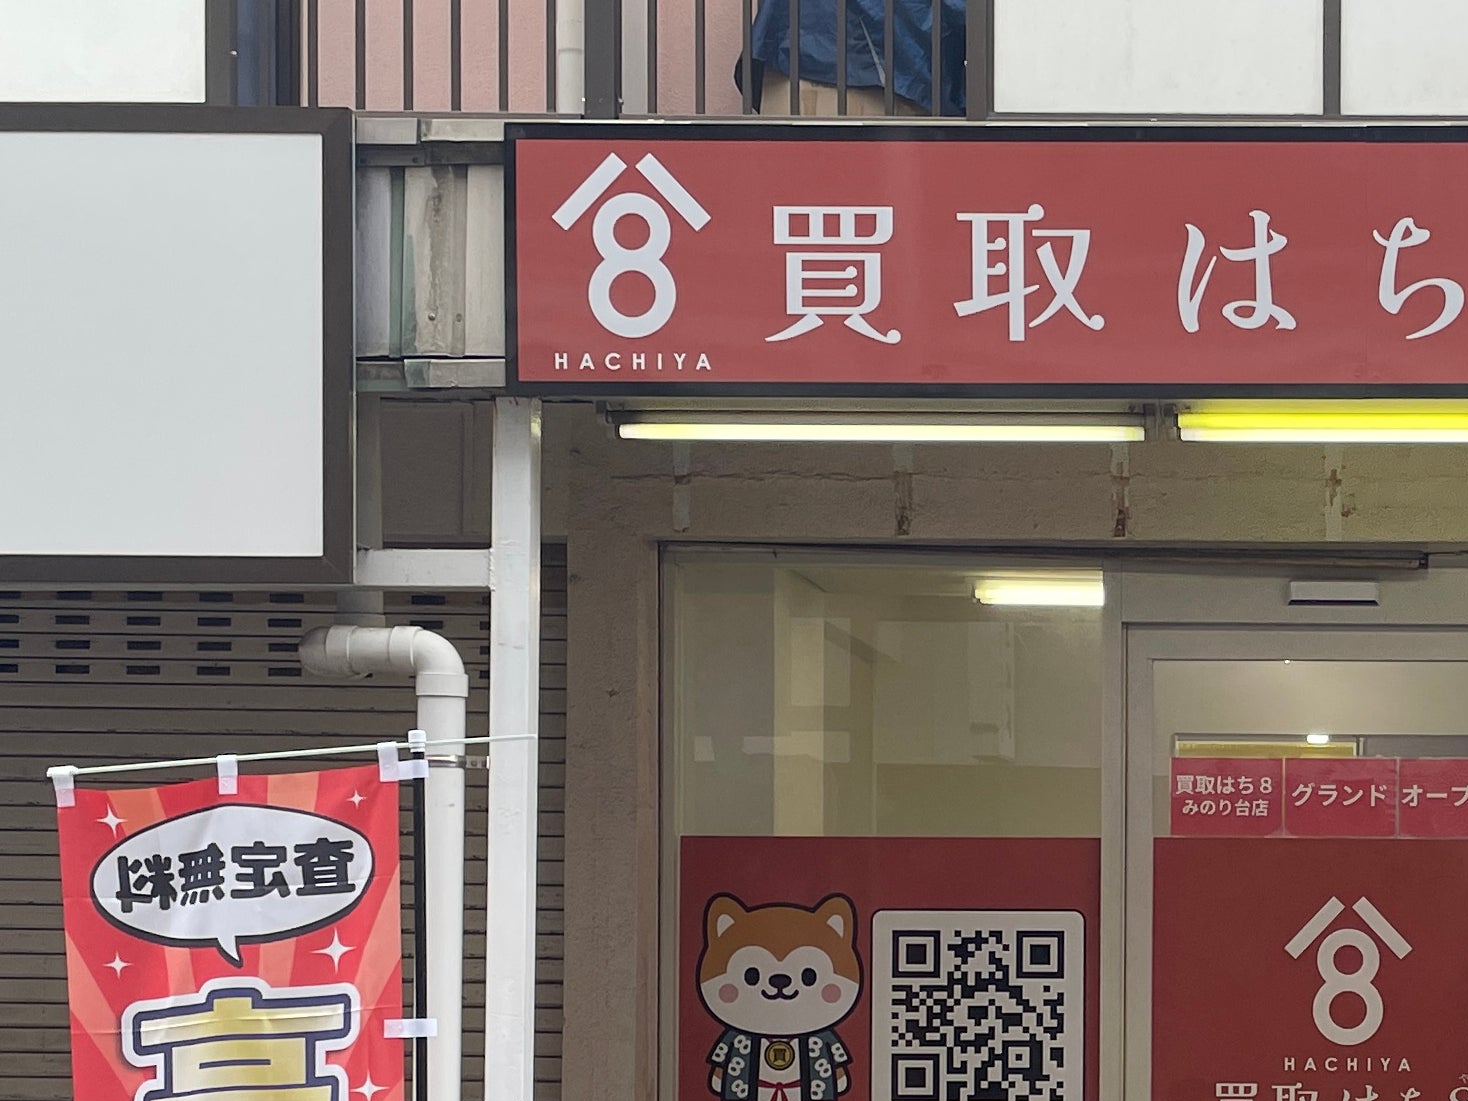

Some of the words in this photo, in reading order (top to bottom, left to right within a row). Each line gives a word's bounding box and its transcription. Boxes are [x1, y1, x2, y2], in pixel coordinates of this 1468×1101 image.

[553, 352, 712, 371] HACHIYA
[1175, 775, 1272, 795] 買取はち8
[1291, 784, 1388, 807] グランド
[1182, 799, 1269, 817] みのり台店
[1284, 1057, 1411, 1072] HACHIYA
